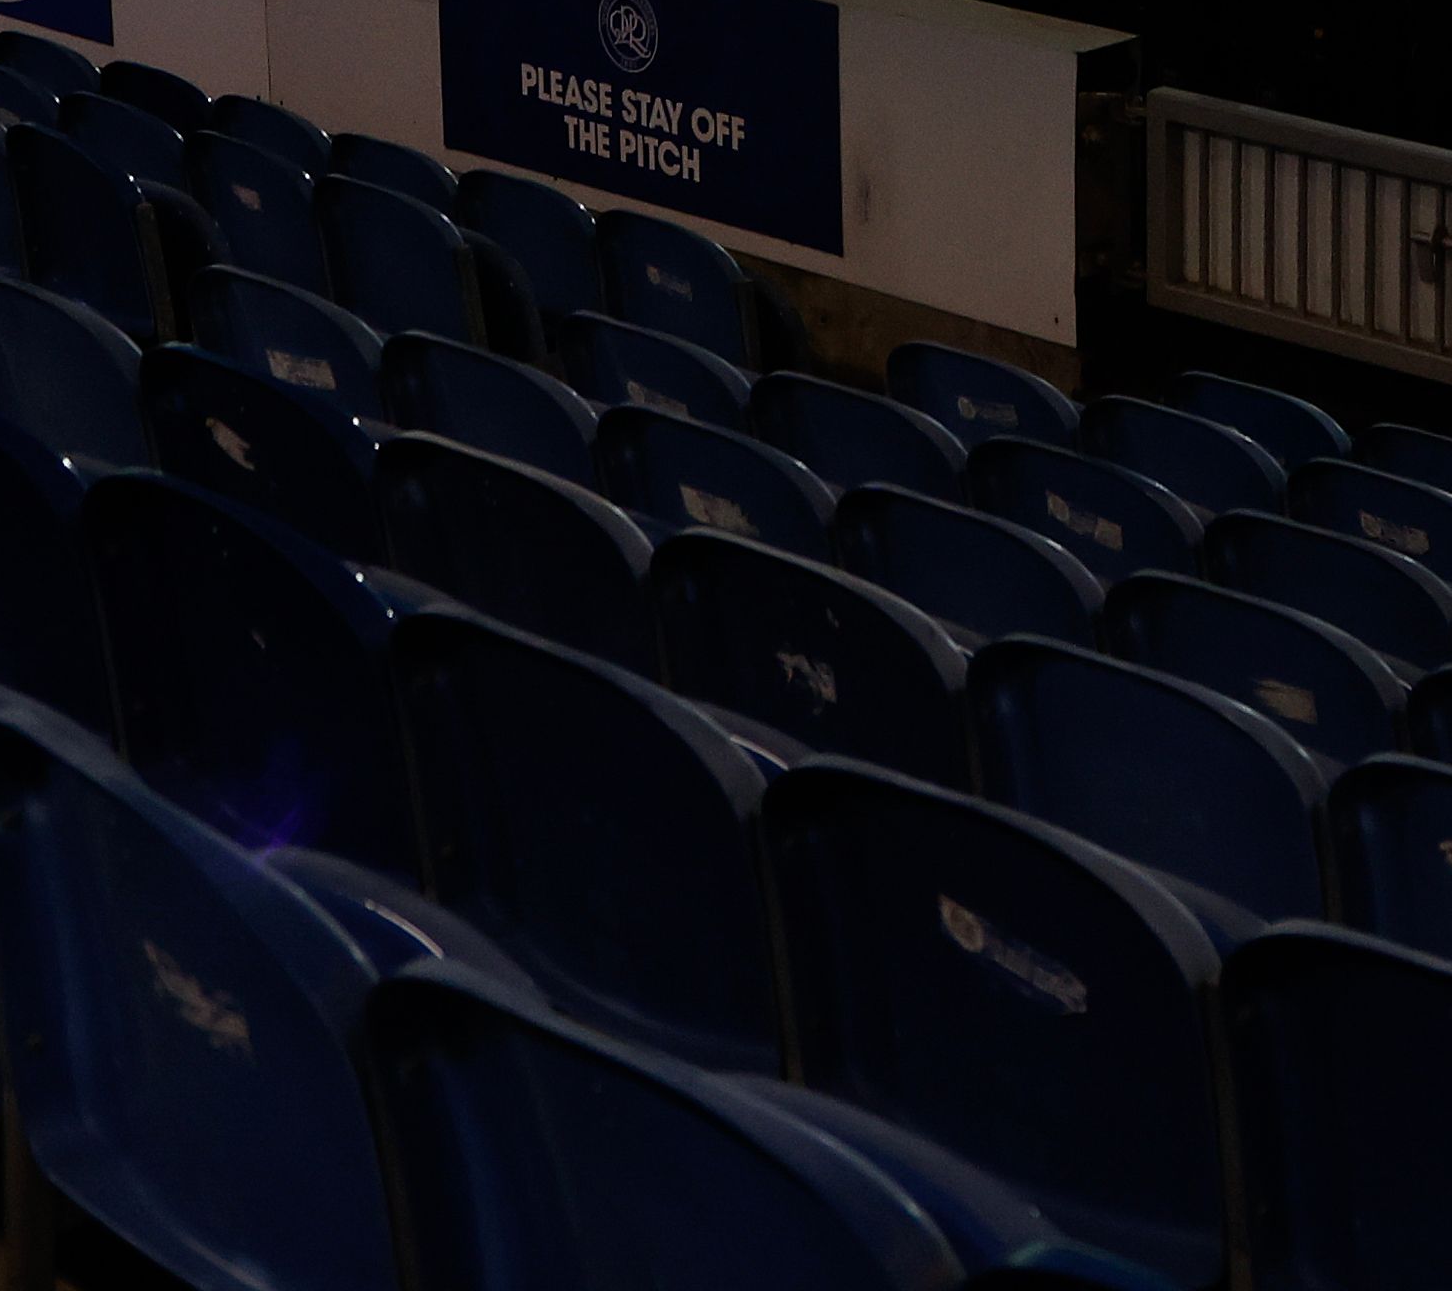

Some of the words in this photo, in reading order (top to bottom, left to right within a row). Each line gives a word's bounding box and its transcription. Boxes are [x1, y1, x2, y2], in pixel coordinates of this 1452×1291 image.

[521, 62, 612, 118] PLEASE
[621, 88, 683, 136] STAY
[691, 107, 745, 151] OFF
[564, 114, 610, 159] THE
[620, 129, 700, 184] PITCH
